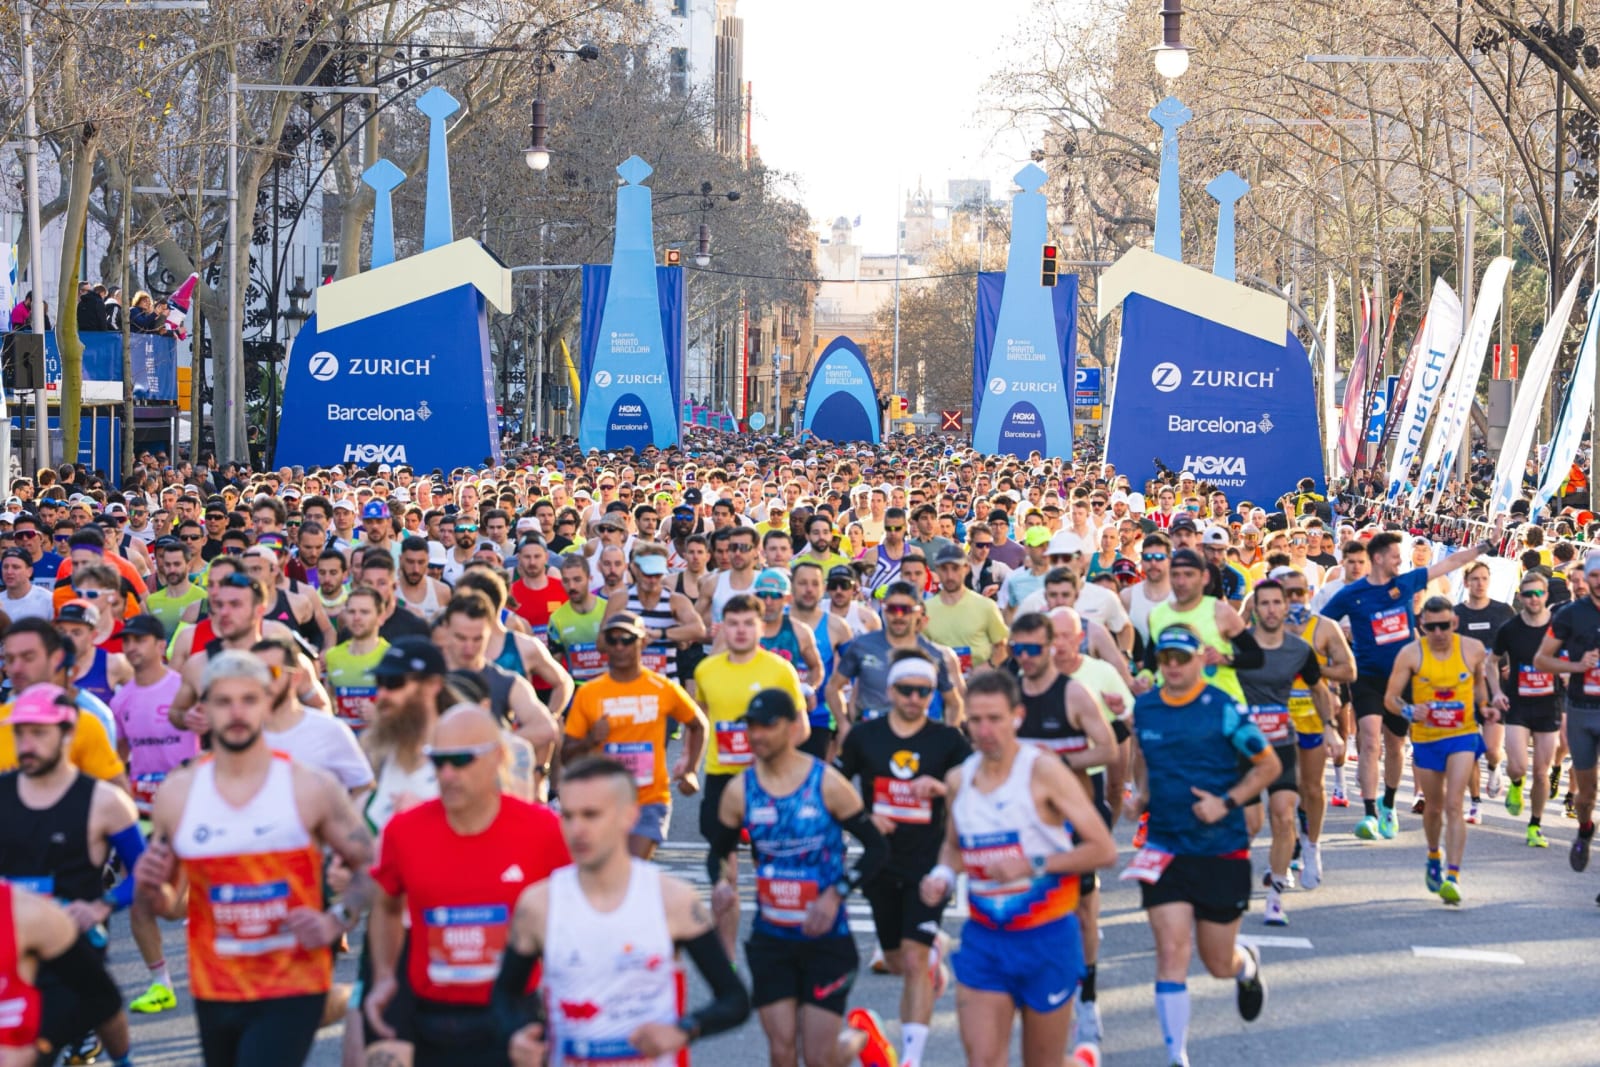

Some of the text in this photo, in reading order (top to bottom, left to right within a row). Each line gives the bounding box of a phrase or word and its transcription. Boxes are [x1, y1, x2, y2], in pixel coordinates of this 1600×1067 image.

[348, 359, 430, 375] ZURICH
[617, 374, 662, 384] ZURICH
[1011, 381, 1057, 393] ZURICH
[1191, 370, 1275, 388] ZURICH
[327, 404, 416, 421] Barcelona
[618, 405, 642, 413] HOKA
[1012, 413, 1036, 421] HOKA
[1168, 415, 1257, 434] Barcelona
[343, 444, 407, 463] HOKA
[1181, 455, 1247, 476] HOKA
[1231, 479, 1246, 487] FLY
